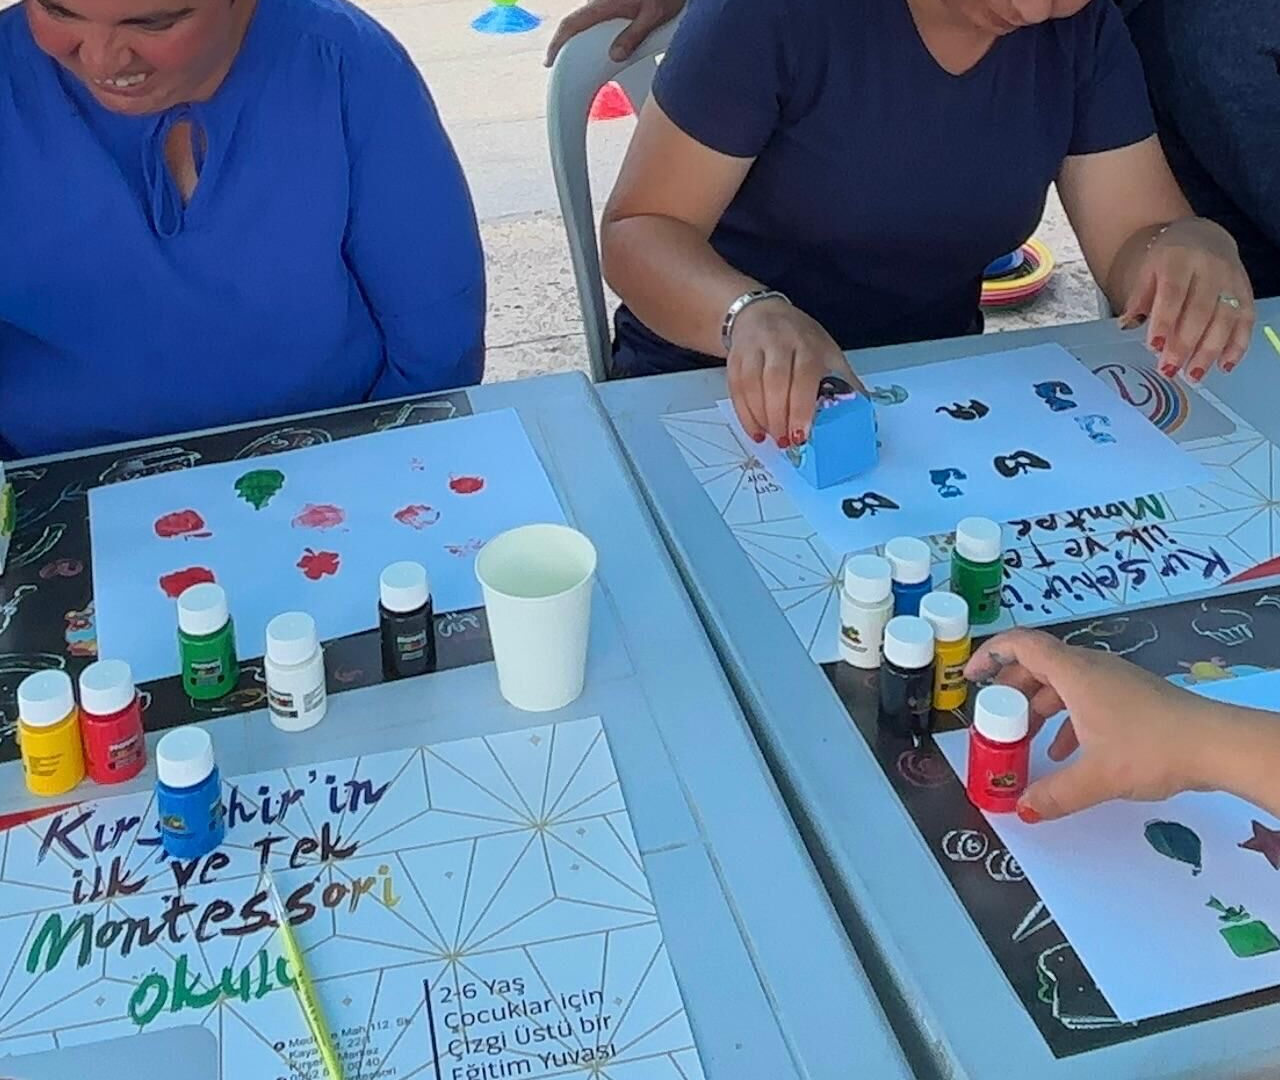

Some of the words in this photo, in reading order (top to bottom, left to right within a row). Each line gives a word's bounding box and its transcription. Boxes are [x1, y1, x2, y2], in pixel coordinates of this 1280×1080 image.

[1064, 535, 1109, 559] ve
[72, 857, 147, 905] ilk
[171, 853, 229, 887] ve
[26, 864, 401, 973] Montessori
[440, 983, 477, 1004] 2-6
[484, 977, 525, 996] Yaş
[444, 998, 552, 1033] Çocuklar
[560, 989, 604, 1013] için
[448, 1031, 507, 1061] Çizgi
[515, 1020, 571, 1045] Üstü
[580, 1014, 612, 1034] bir
[452, 1058, 531, 1080] Eğitim
[538, 1043, 617, 1070] Yuvası
